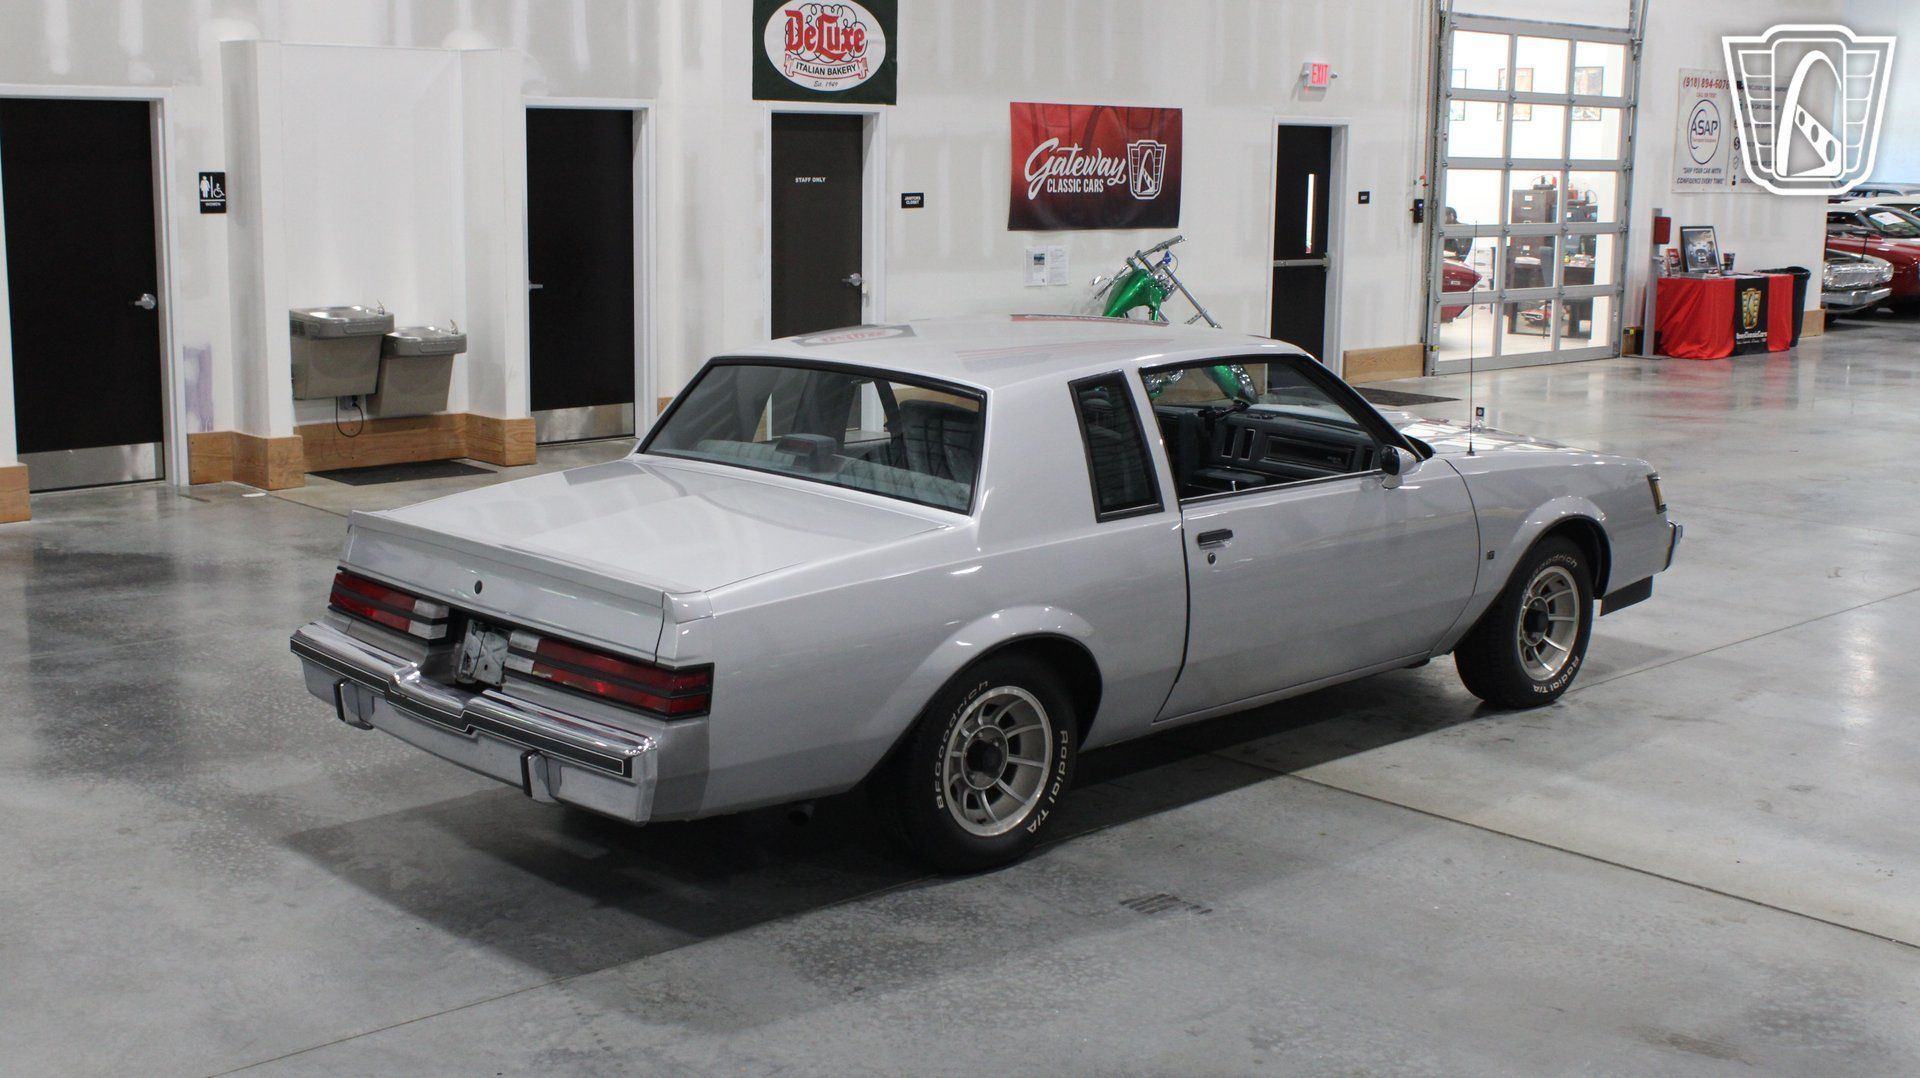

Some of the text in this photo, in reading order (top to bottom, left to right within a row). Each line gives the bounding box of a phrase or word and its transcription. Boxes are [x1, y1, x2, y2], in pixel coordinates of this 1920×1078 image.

[785, 9, 865, 60] DeLuxe
[796, 61, 857, 76] ITALIAN BAKERY
[1311, 63, 1329, 85] EXIT
[1692, 120, 1718, 136] ASAP
[1024, 137, 1126, 200] Gateway
[1047, 178, 1104, 193] CLASSIC CARS
[1550, 655, 1580, 693] Radial
[934, 680, 989, 809] BFGoodrich
[1026, 730, 1069, 834] Radial T/A
